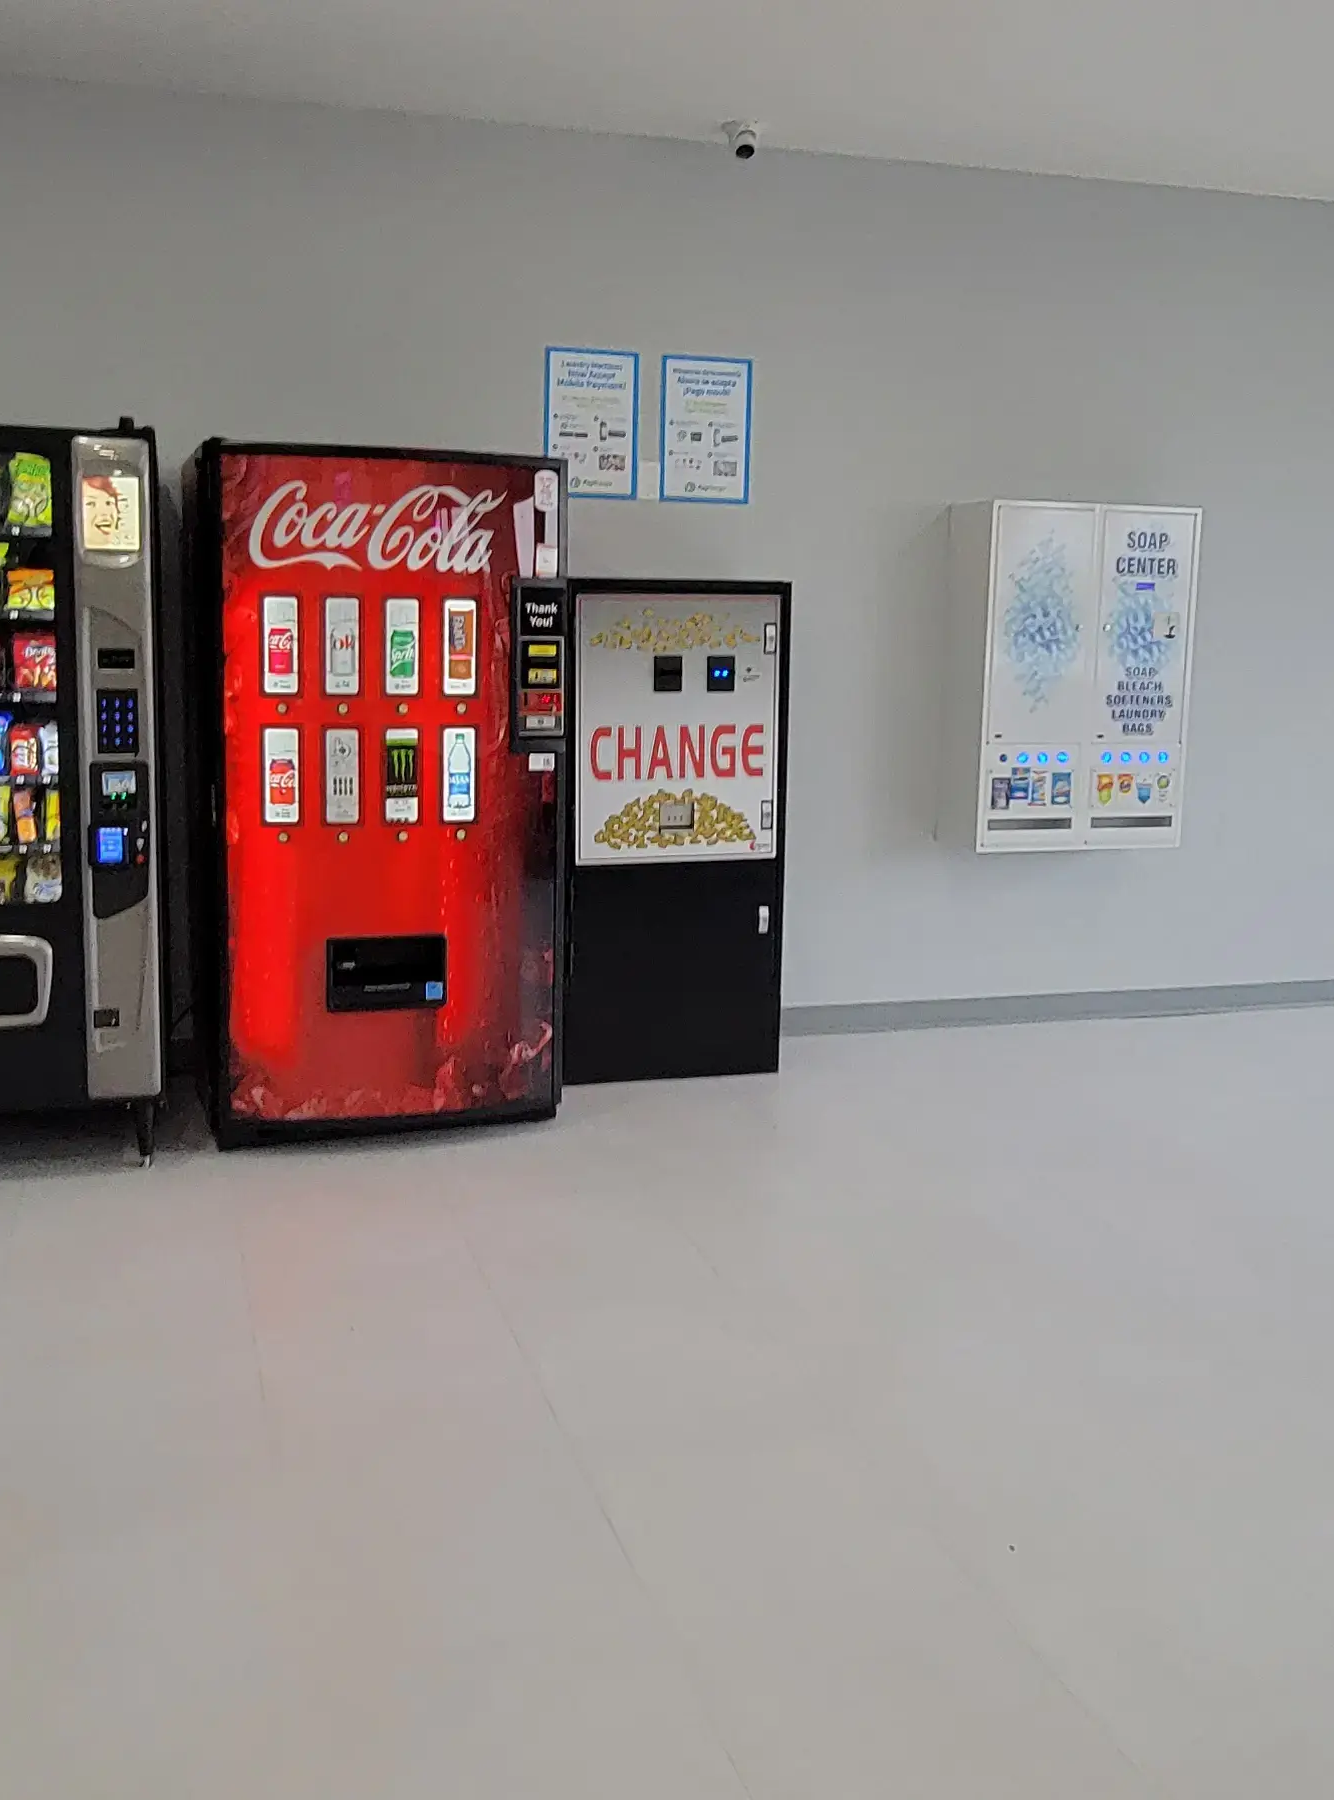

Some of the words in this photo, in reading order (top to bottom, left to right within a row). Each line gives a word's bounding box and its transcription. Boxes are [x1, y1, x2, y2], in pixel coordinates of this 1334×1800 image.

[249, 479, 508, 574] Coca-Cola
[1127, 531, 1170, 550] SOAP
[1116, 556, 1177, 576] CENTER
[525, 602, 558, 614] Thank
[530, 615, 553, 628] You!
[1125, 666, 1158, 677] SOAP
[1117, 681, 1162, 691] BLEACH
[1106, 694, 1173, 706] SOFTENERS
[1111, 709, 1165, 720] LAUNDRY
[1122, 723, 1153, 734] BAGS
[590, 723, 764, 781] CHANGE
